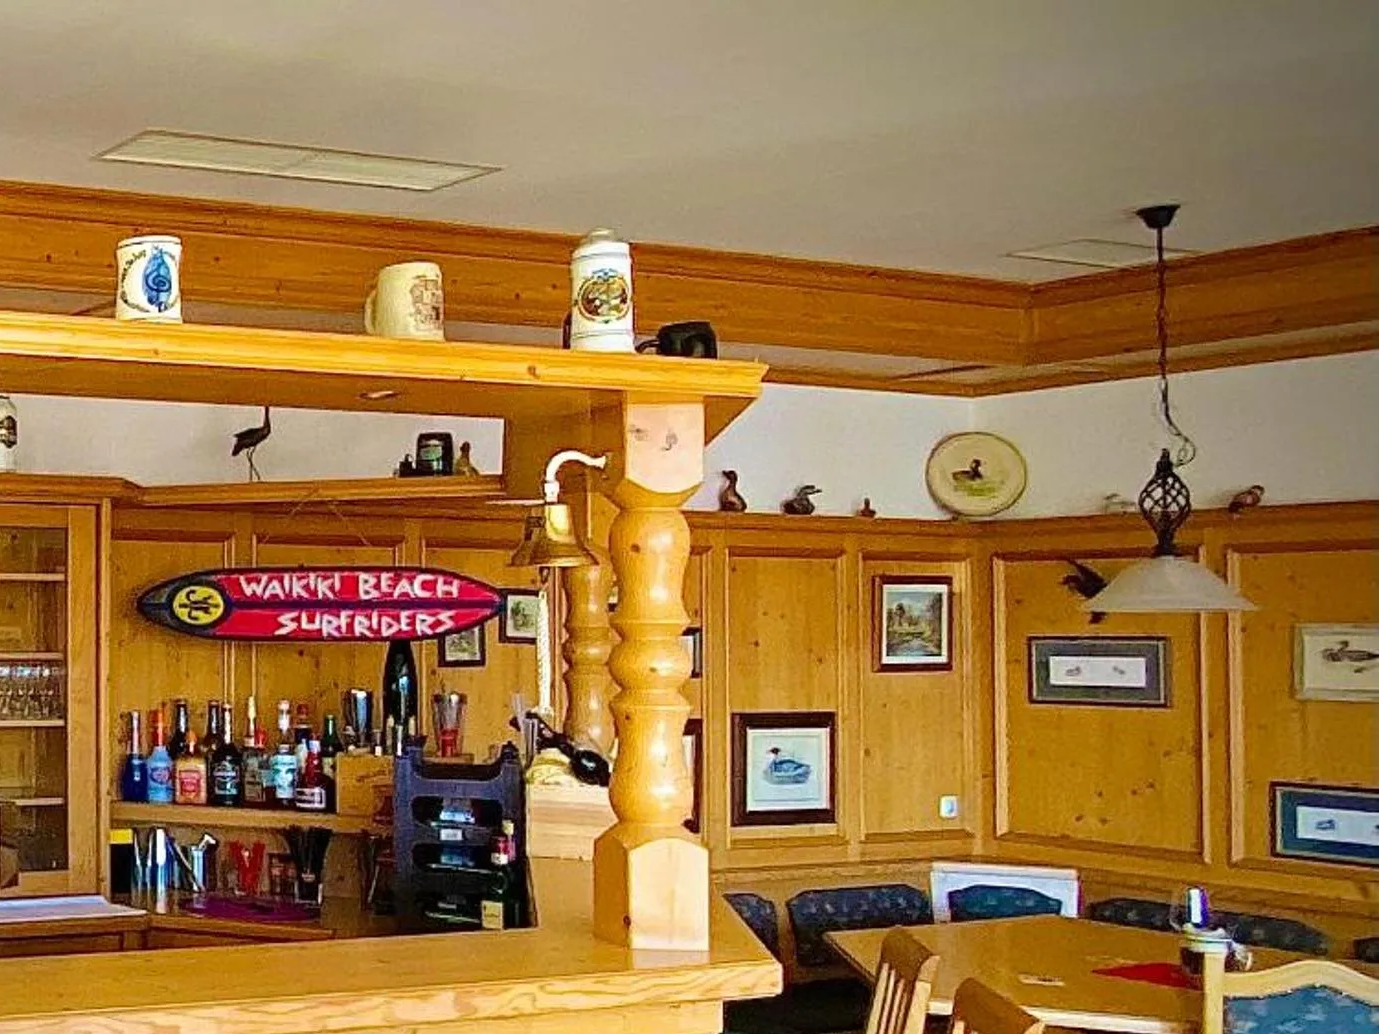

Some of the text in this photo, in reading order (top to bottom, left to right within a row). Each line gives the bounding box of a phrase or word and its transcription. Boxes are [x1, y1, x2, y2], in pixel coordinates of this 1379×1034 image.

[238, 573, 459, 600] WAIKIKI BEACH
[274, 610, 456, 638] SURFRIDERS
